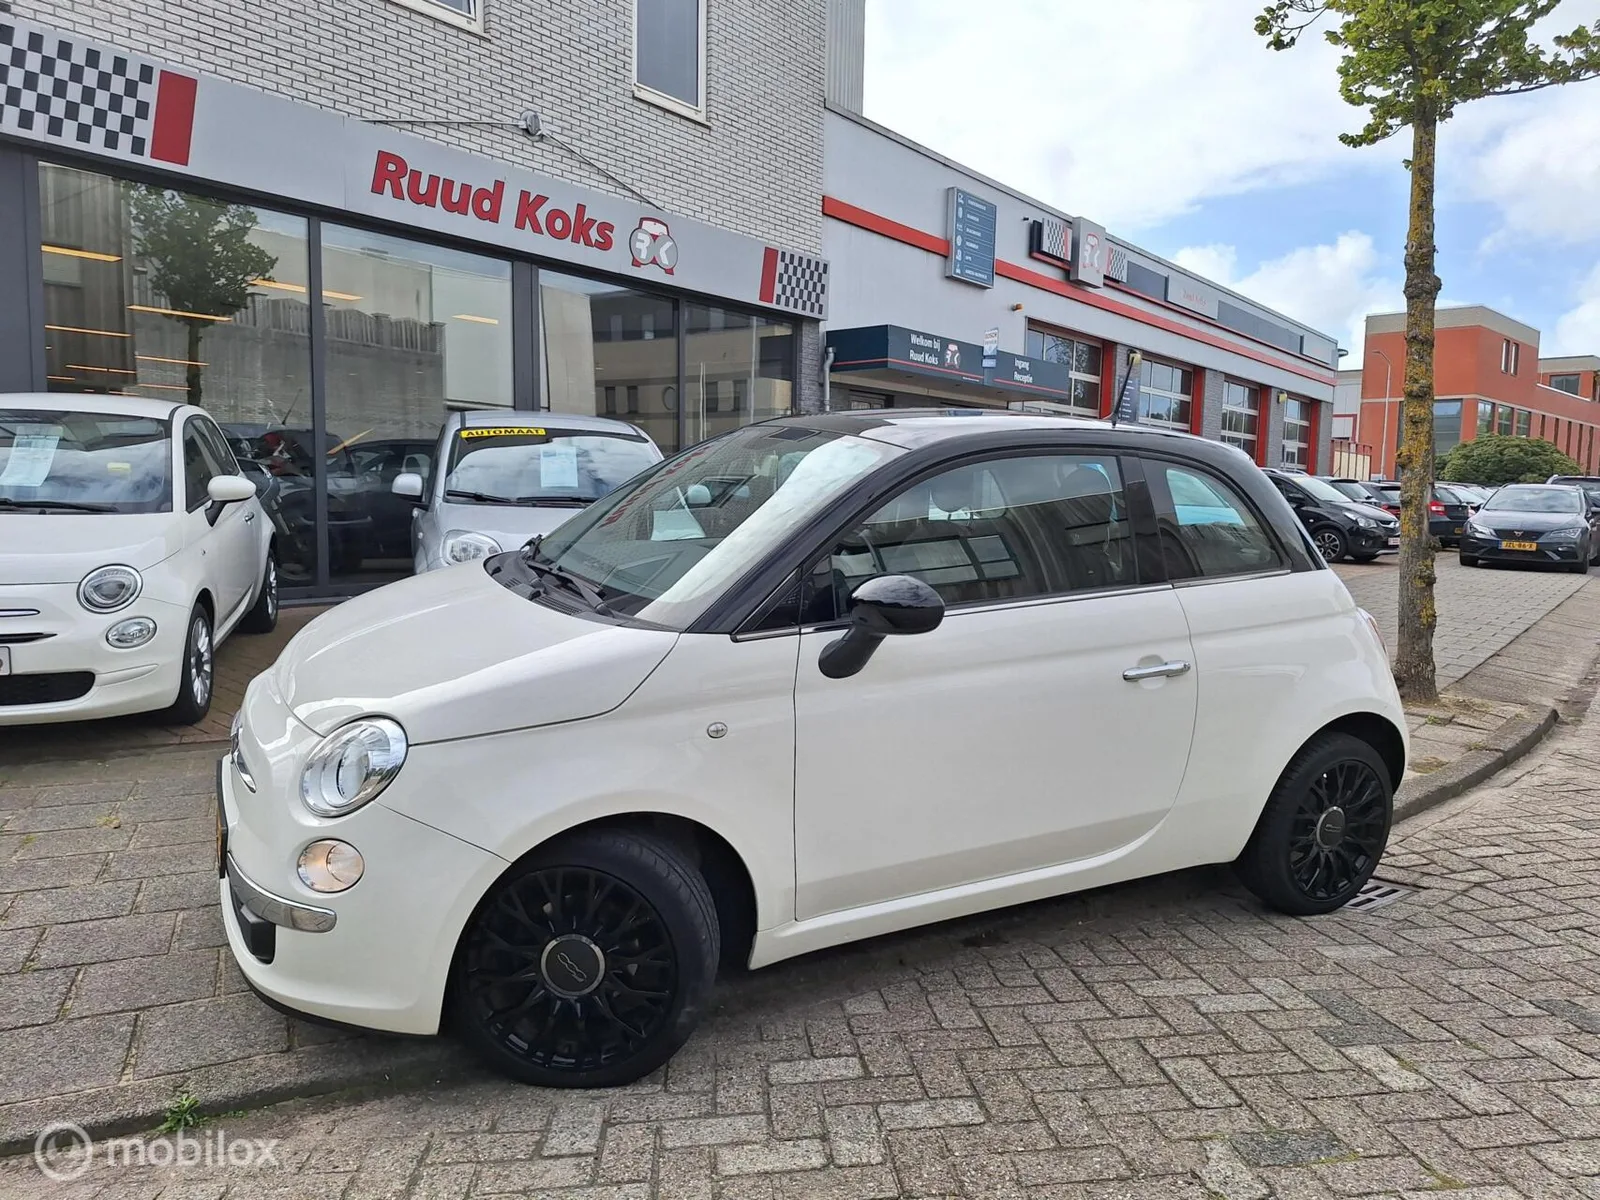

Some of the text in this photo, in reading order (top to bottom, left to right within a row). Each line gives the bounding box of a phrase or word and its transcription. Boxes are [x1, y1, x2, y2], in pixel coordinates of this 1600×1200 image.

[371, 150, 615, 250] Ruud Koks
[910, 333, 932, 347] Welkom
[909, 349, 939, 365] Ruud Koks
[1014, 357, 1029, 371] Ingang
[1013, 371, 1033, 384] Receptie
[466, 428, 541, 437] AUTOMAAT
